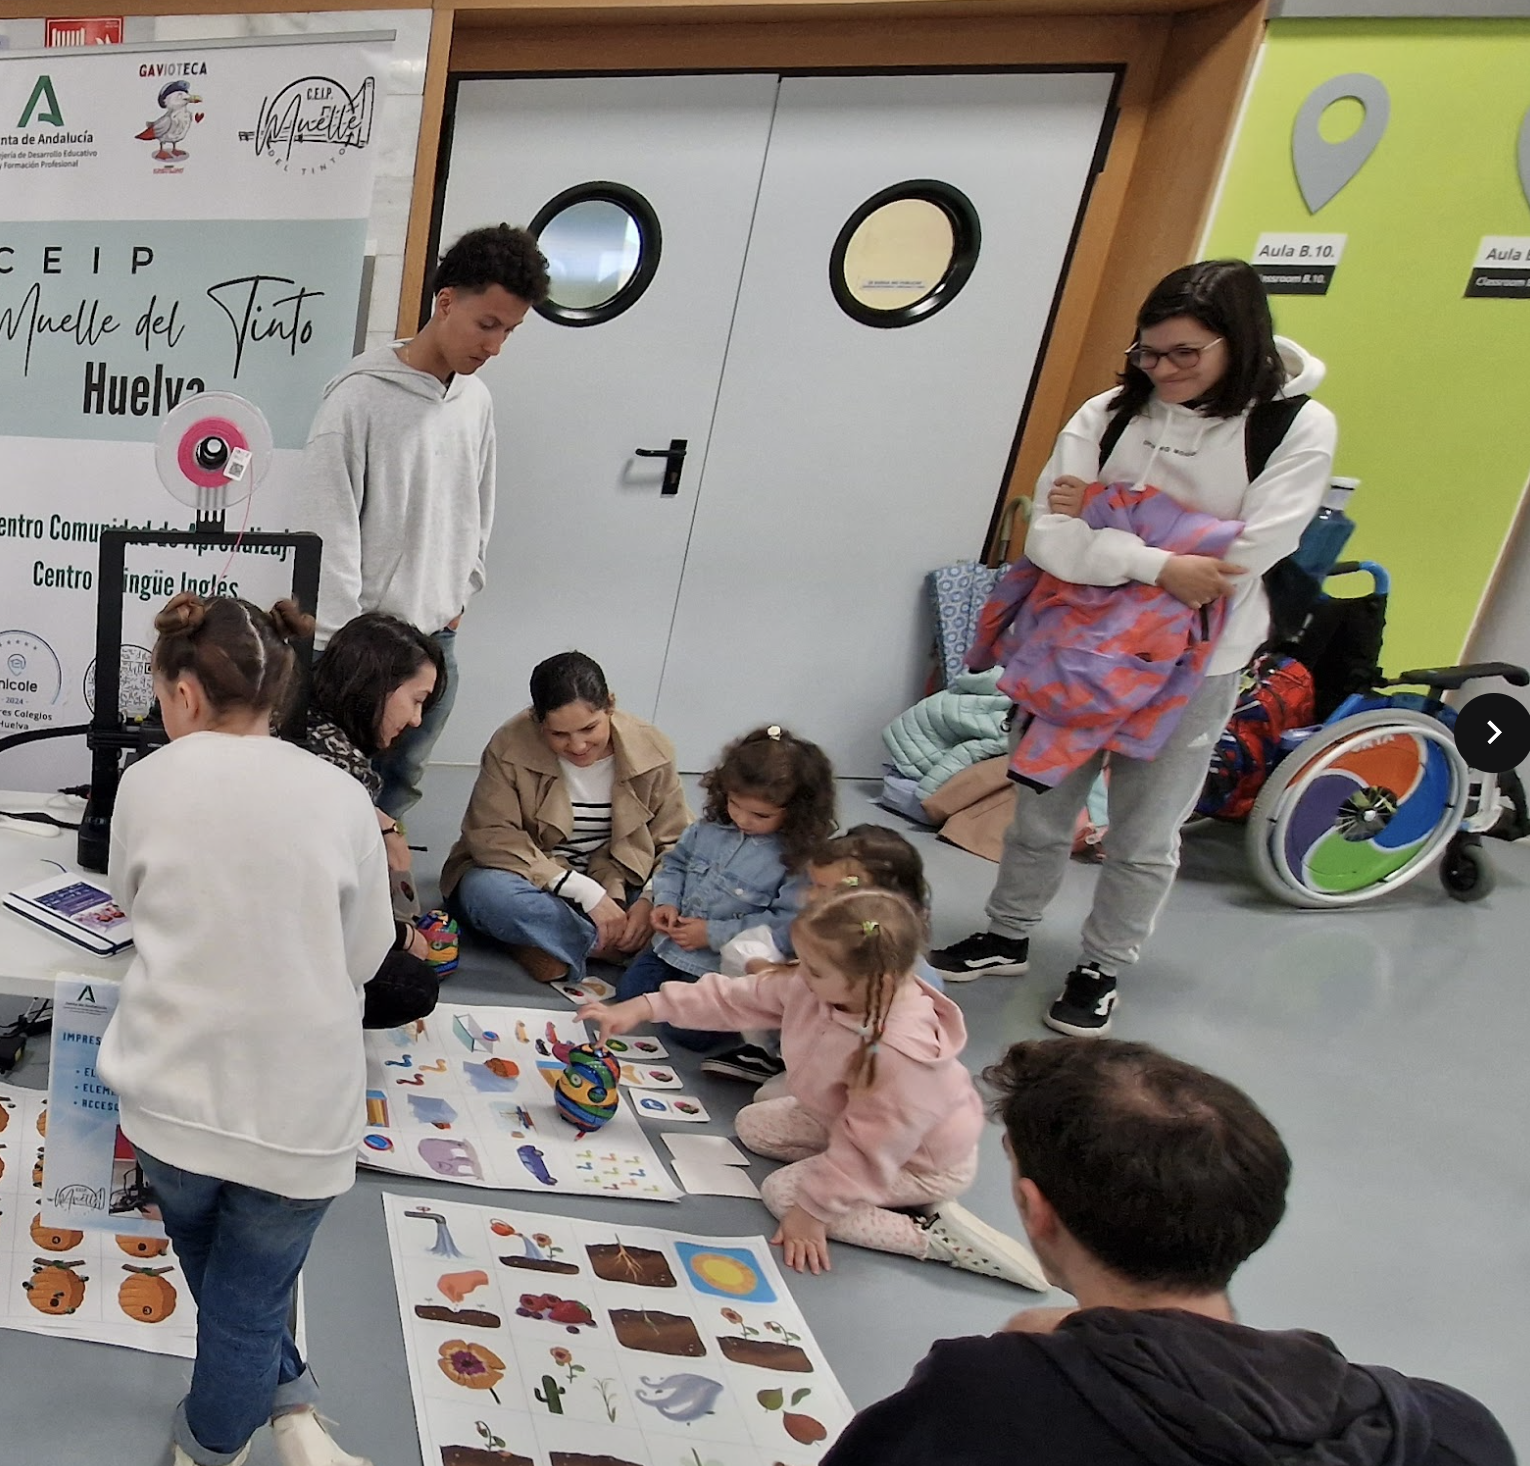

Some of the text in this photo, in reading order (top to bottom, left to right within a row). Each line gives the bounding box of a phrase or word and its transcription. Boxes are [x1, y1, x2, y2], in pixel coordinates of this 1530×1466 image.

[139, 61, 208, 78] GAVIOTECA
[21, 133, 36, 145] de
[38, 130, 94, 144] Andalucía
[18, 151, 27, 159] de
[28, 150, 62, 159] Desarrollo
[63, 150, 98, 158] Educativo
[4, 161, 39, 170] Formación
[41, 160, 79, 168] Profesional
[1258, 244, 1335, 258] Aula B.10.
[1485, 248, 1522, 261] Aula
[135, 294, 186, 352] del
[207, 274, 325, 380] Tinto
[33, 560, 93, 591] Centro
[181, 571, 239, 599] Inglés
[14, 709, 53, 721] Colegios
[62, 1032, 102, 1046] IMPRES
[82, 1098, 120, 1112] ACCESO
